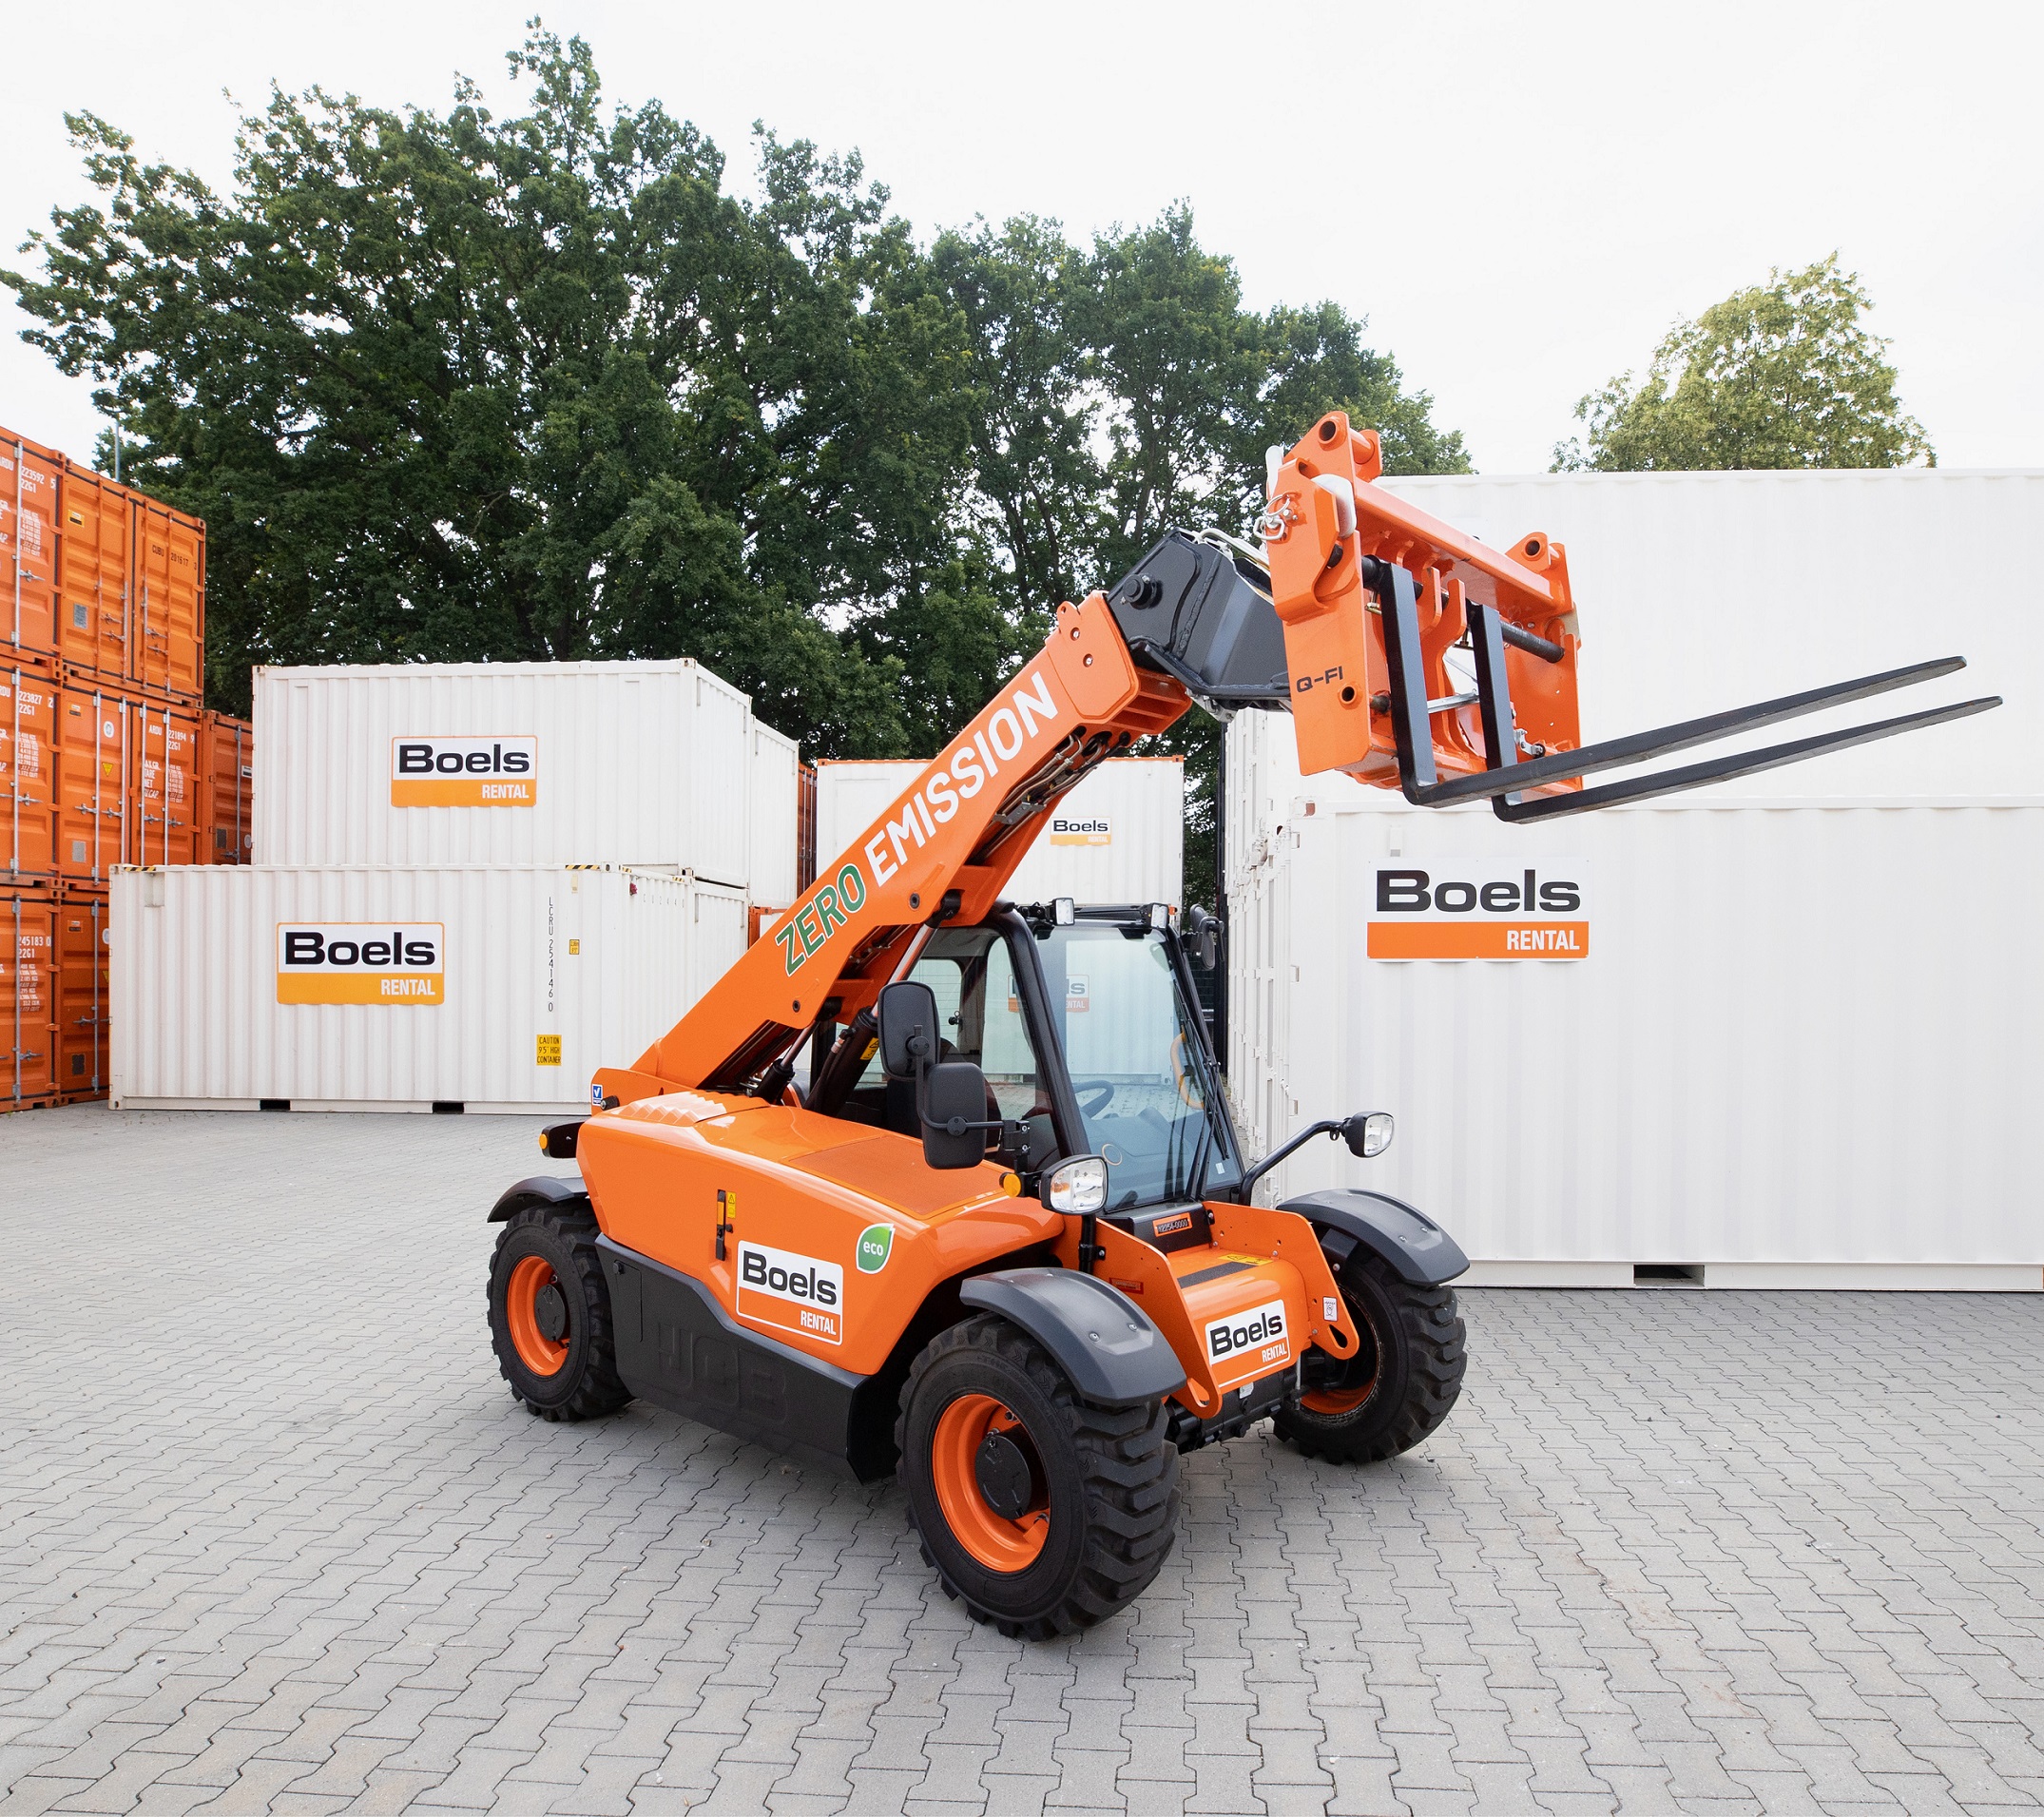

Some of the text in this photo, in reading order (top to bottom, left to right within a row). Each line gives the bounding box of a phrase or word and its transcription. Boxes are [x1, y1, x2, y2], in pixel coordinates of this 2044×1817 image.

[21, 466, 45, 485] 223592
[50, 477, 56, 490] 5
[1296, 666, 1344, 694] Q-FI
[19, 690, 43, 706] 223827
[148, 725, 163, 736] ARDU
[169, 729, 187, 742] 221894
[399, 744, 530, 774] Boels
[481, 783, 530, 800] RENTAL
[775, 862, 867, 977] ZERO
[864, 671, 1058, 887] EMISSION
[1053, 820, 1109, 832] Boels
[1376, 869, 1581, 913] Boels
[285, 931, 435, 966] Boels
[1507, 929, 1580, 951] RENTAL
[380, 978, 436, 995] RENTAL
[538, 1036, 560, 1045] CAUTION
[536, 1055, 562, 1064] CONTAINER
[863, 1241, 884, 1257] eco
[742, 1249, 837, 1305] Boels
[800, 1310, 837, 1336] RENTAL
[1209, 1312, 1282, 1357] Boels
[1261, 1342, 1287, 1363] RENTAL
